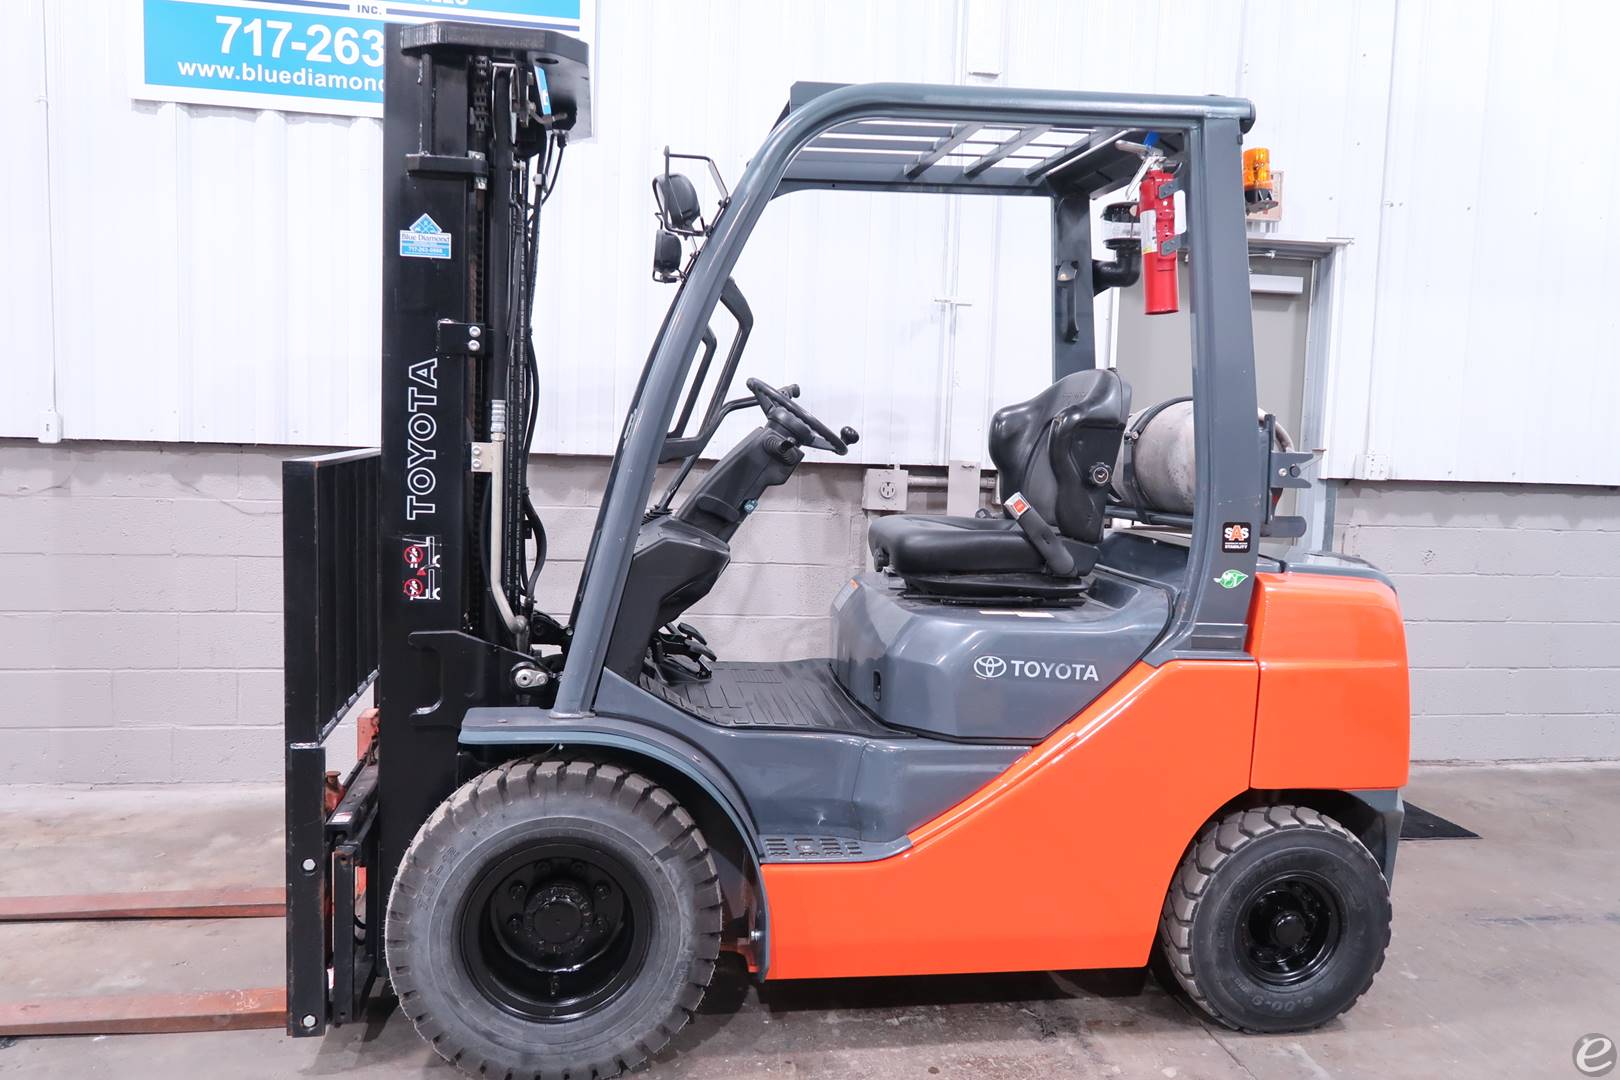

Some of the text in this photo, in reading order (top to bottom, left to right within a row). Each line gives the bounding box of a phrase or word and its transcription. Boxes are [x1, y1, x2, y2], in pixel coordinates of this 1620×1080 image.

[357, 4, 382, 15] INC.
[401, 233, 450, 243] Blue Diamond
[406, 358, 438, 520] TOYOTA
[1224, 525, 1249, 541] SAS
[1010, 660, 1100, 682] TOYOTA
